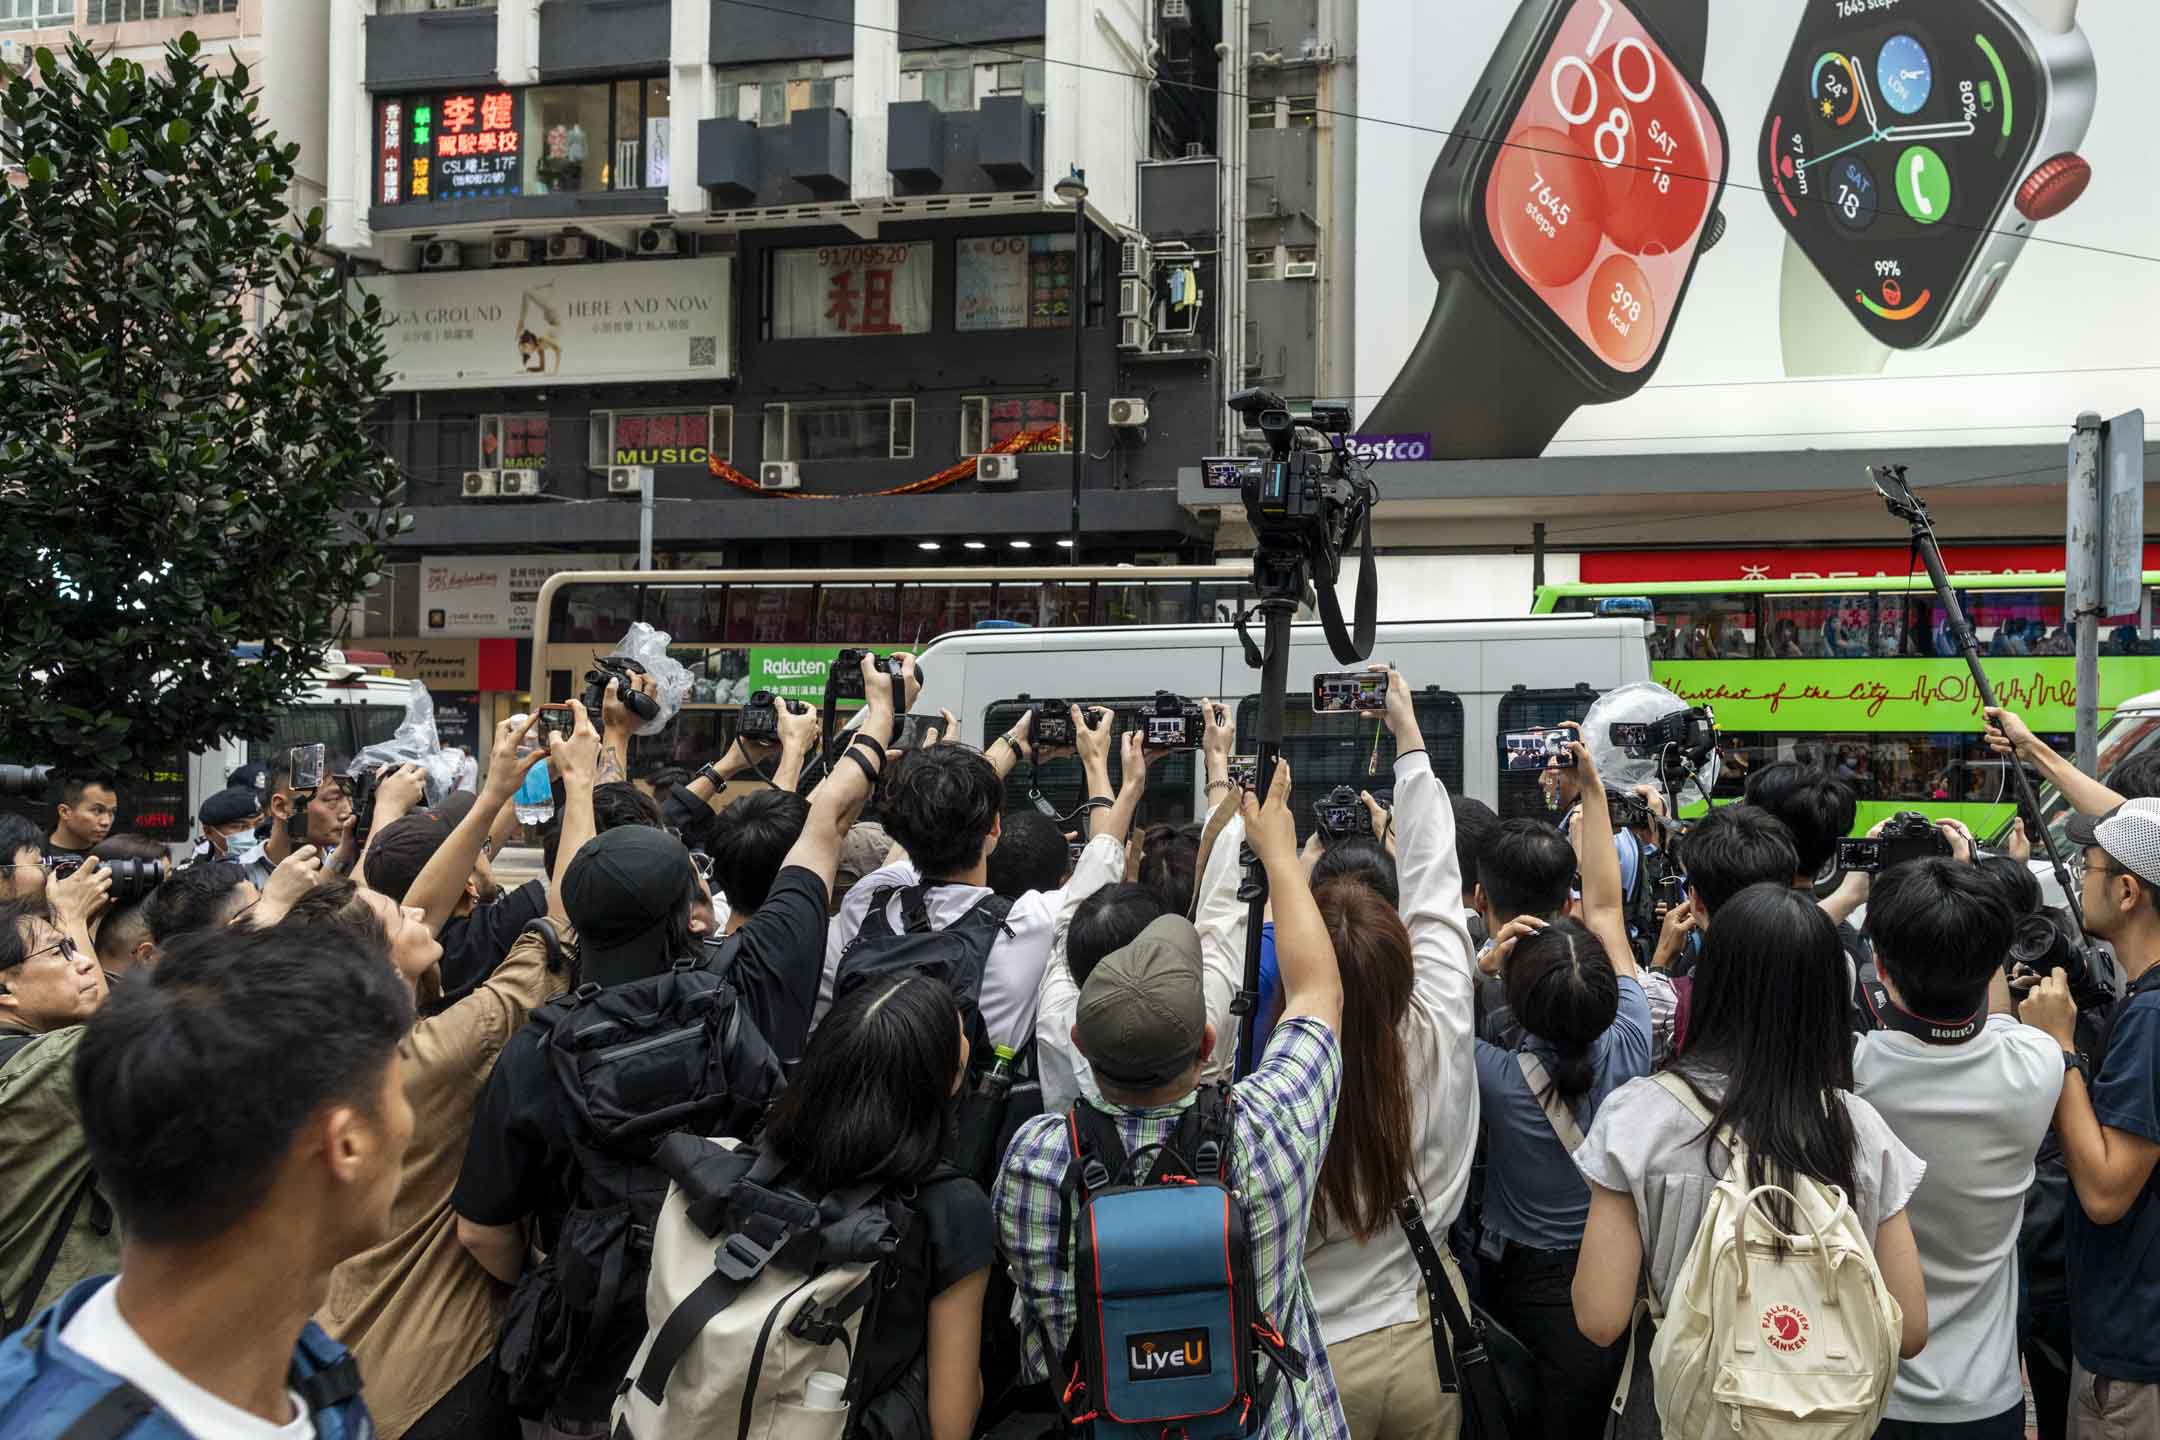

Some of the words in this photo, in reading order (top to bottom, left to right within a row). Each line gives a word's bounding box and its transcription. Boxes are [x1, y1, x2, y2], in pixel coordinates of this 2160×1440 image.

[442, 92, 513, 133] 李健
[1959, 80, 1978, 121] 80%
[437, 131, 518, 157] 駕駛學校
[1648, 119, 1678, 157] SAT
[1791, 134, 1804, 153] 97
[1651, 166, 1671, 193] 18
[1795, 158, 1809, 194] bpm
[1846, 164, 1870, 192] SAT
[1528, 172, 1571, 225] 7645
[1525, 201, 1557, 238] steps
[1874, 260, 1901, 277] 99%
[381, 309, 420, 325] OGA
[425, 305, 502, 323] GROUND
[567, 300, 612, 318] HERE
[622, 299, 658, 315] AND
[665, 296, 712, 312] NOW
[823, 269, 904, 333] 租
[1610, 282, 1641, 322] 398
[1607, 308, 1632, 337] kcal
[504, 457, 546, 469] MAGIC
[616, 447, 707, 465] MUSIC
[1345, 439, 1425, 461] Bestco
[763, 658, 826, 679] Rakuten
[1764, 682, 1792, 714] of
[1802, 685, 1833, 700] the
[1847, 681, 1892, 718] City
[1931, 1023, 1975, 1039] Canon
[1131, 1338, 1204, 1375] LiveU
